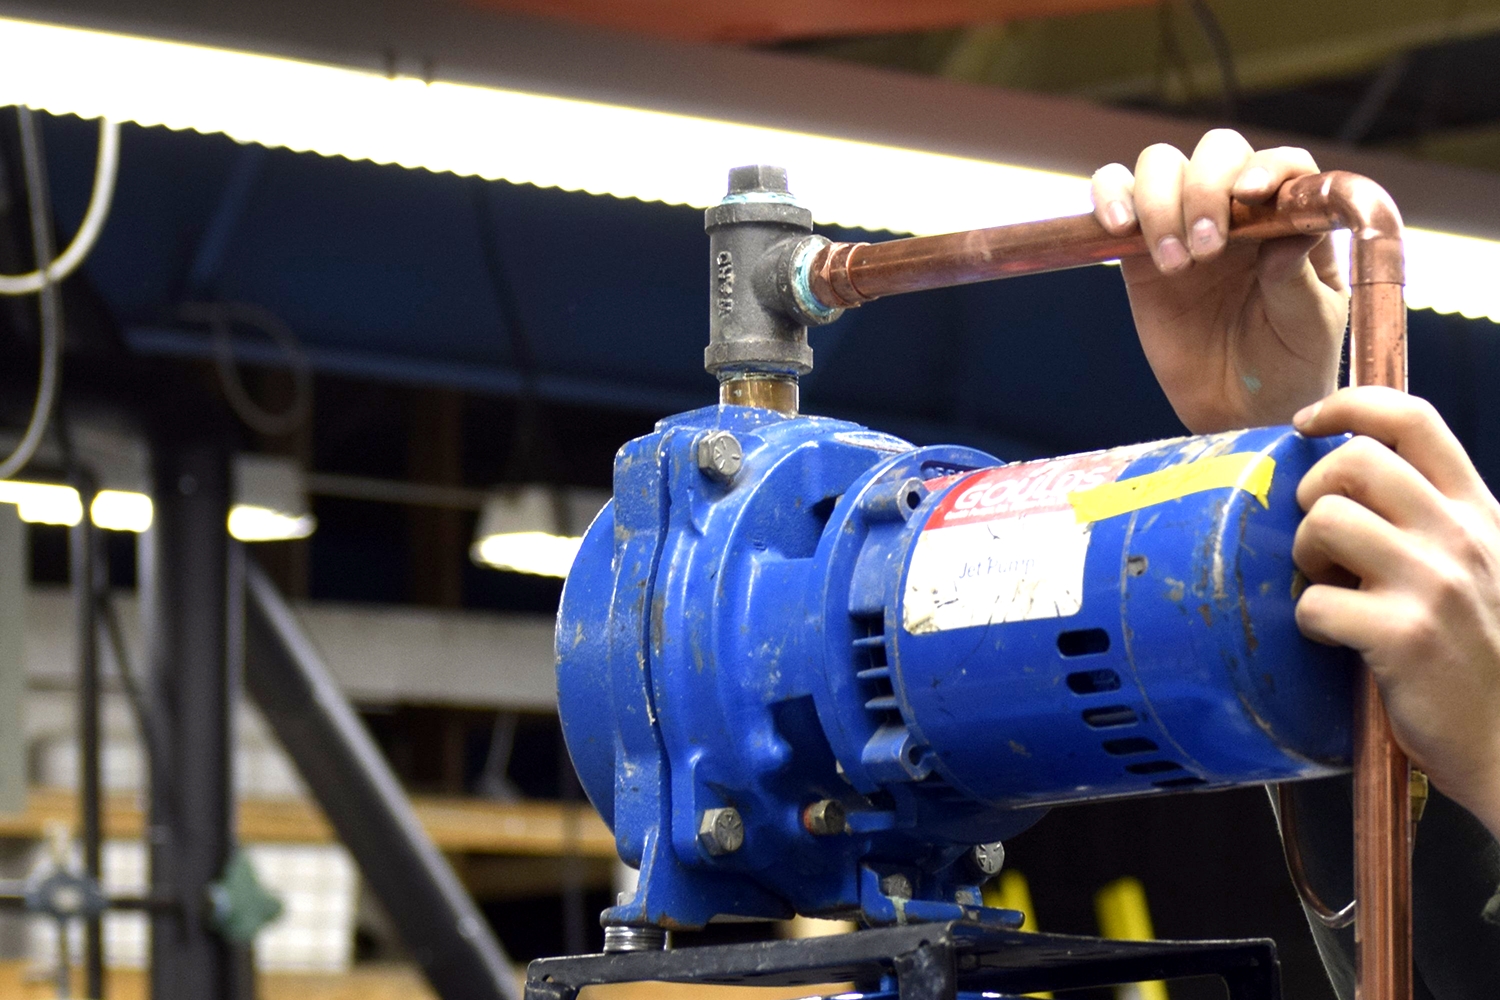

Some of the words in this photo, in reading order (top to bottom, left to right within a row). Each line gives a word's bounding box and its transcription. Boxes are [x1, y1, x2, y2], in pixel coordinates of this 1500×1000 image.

[953, 463, 1113, 510] GOULDS
[958, 561, 982, 579] Jet
[986, 556, 1035, 575] Pump
